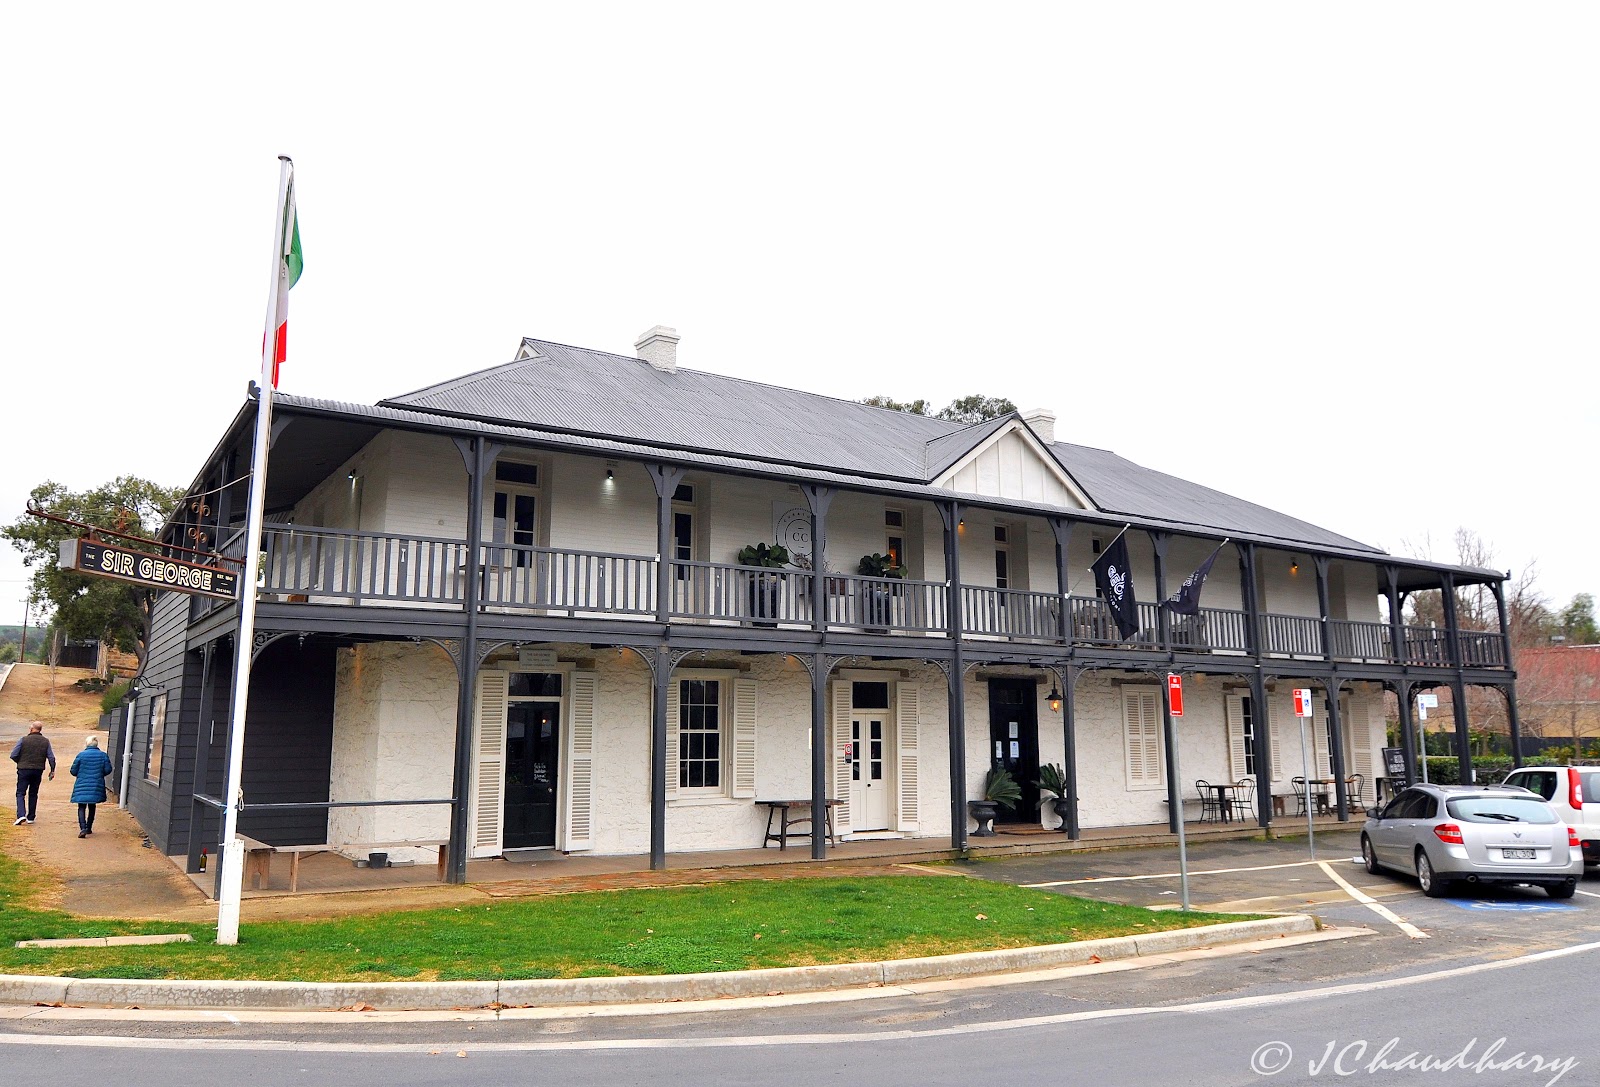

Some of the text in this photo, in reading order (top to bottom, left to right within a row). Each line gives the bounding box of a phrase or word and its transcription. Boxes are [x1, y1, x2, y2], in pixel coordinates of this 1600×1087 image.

[792, 532, 809, 543] CC
[101, 549, 213, 591] SIR GEORGE
